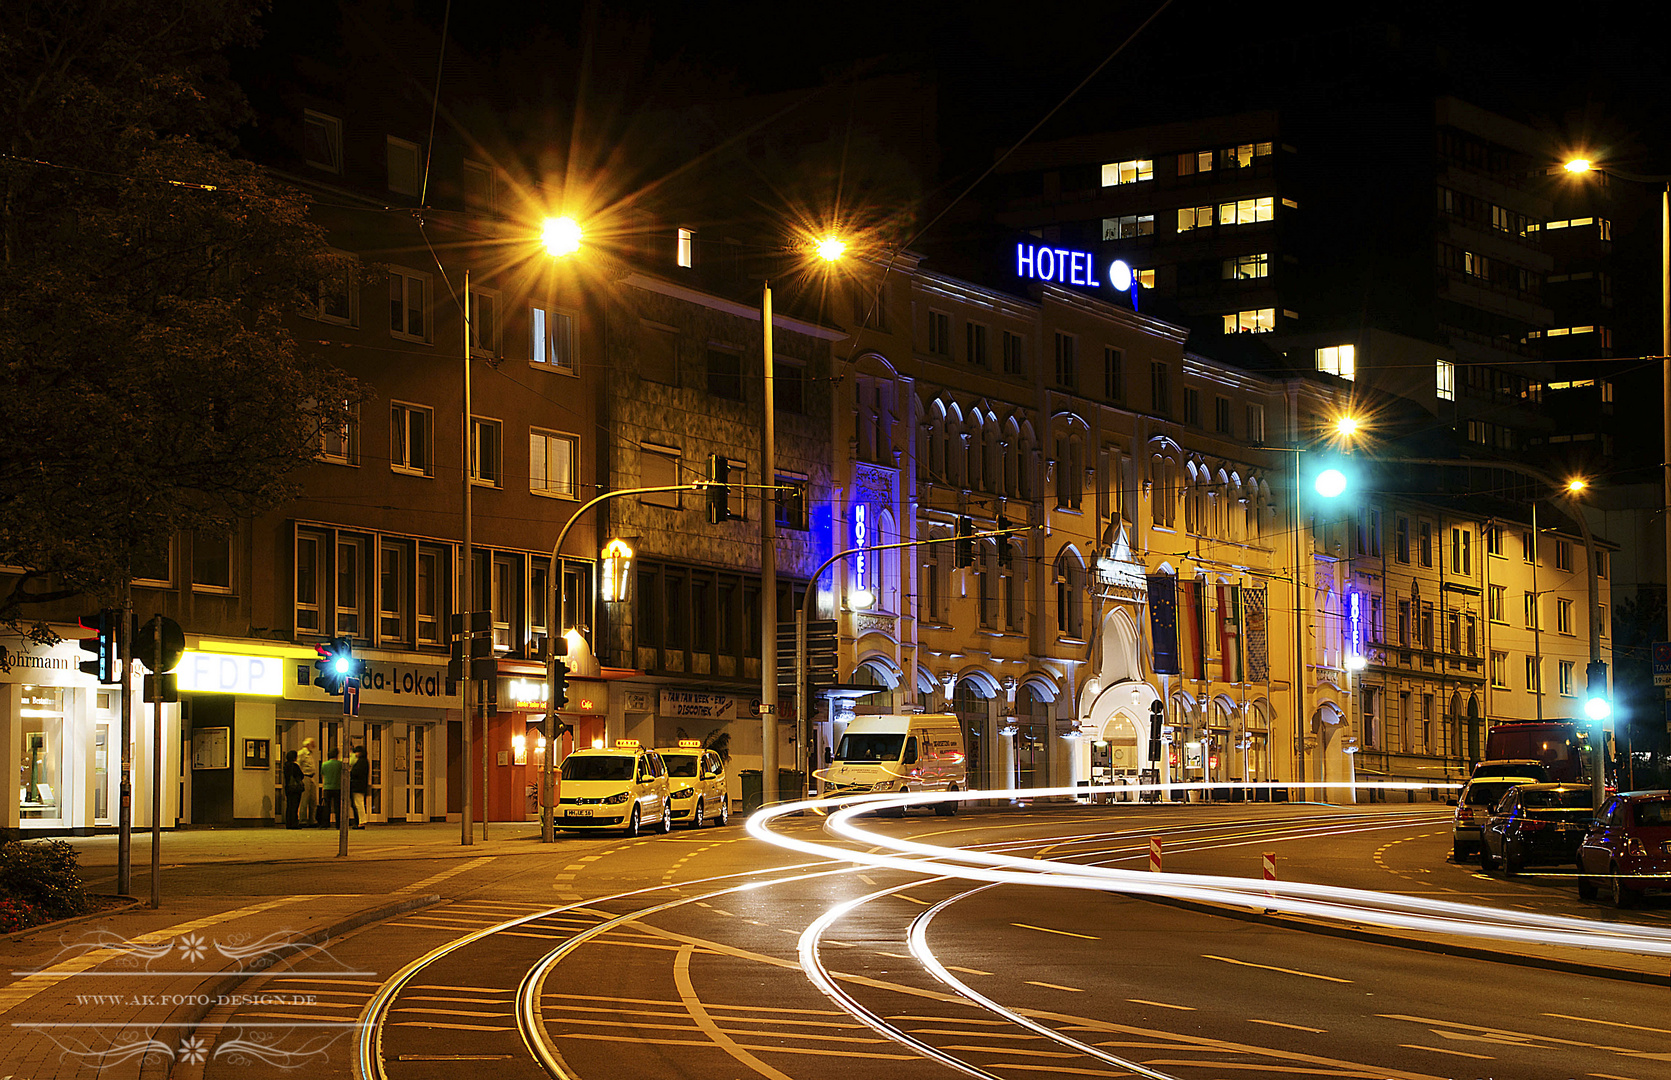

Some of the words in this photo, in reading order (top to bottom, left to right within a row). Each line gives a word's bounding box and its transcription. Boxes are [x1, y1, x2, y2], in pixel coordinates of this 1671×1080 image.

[1017, 243, 1100, 287] HOTEL
[855, 504, 866, 591] HOTEL
[1350, 592, 1360, 657] HOTEL
[5, 650, 68, 670] ohrmann
[194, 655, 265, 690] FDP
[359, 667, 440, 697] da-Lokal
[678, 705, 712, 717] DISCOTHEK
